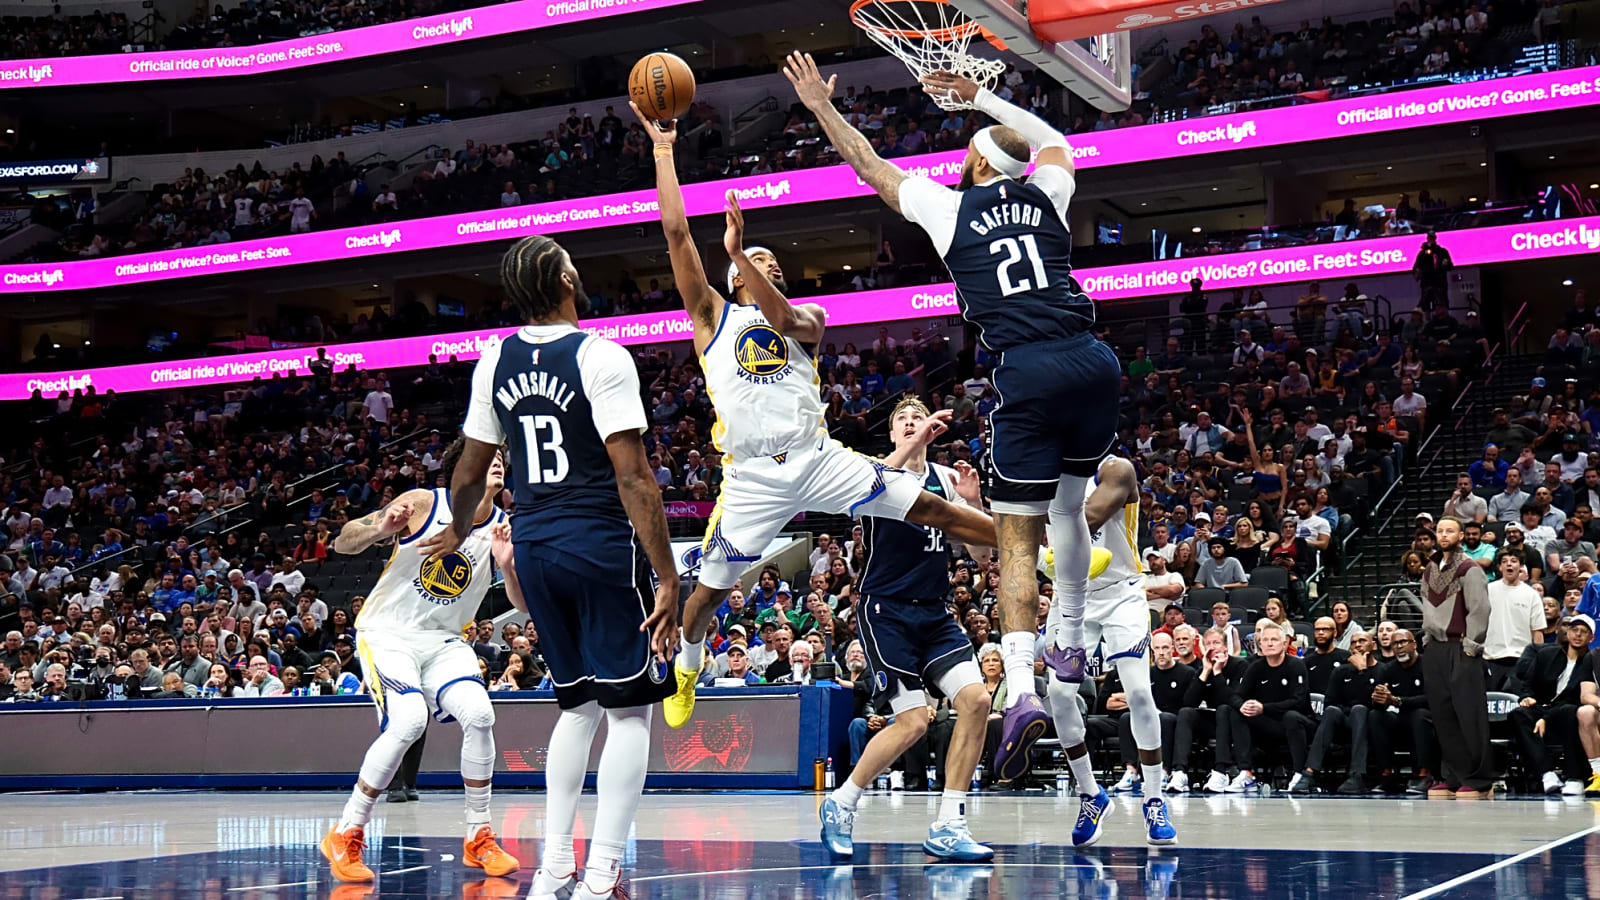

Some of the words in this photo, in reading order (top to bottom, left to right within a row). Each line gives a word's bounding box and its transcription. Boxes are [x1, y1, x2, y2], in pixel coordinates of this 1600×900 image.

[546, 0, 589, 16] Official
[413, 23, 449, 39] Check
[451, 16, 472, 36] lyft
[130, 60, 173, 72] Official
[176, 59, 199, 70] ride
[202, 57, 214, 68] of
[216, 55, 255, 67] Voice?
[257, 52, 287, 64] Gone.
[289, 46, 314, 59] Feet:
[316, 43, 343, 54] Sore.
[29, 65, 52, 82] lyft
[652, 65, 667, 110] Wilson
[1337, 106, 1392, 124] Official
[1395, 103, 1425, 117] ride
[1428, 99, 1444, 113] of
[1446, 92, 1498, 110] Voice?
[1501, 89, 1548, 104] Gone.
[1551, 81, 1592, 97] Feet:
[1178, 127, 1226, 145] Check
[1227, 121, 1256, 142] lyft
[930, 163, 946, 176] of
[766, 180, 790, 200] lyft
[457, 220, 495, 234] Official
[497, 218, 518, 230] ride
[520, 215, 531, 227] of
[532, 211, 568, 225] Voice?
[570, 209, 601, 220] Gone.
[603, 204, 630, 216] Feet:
[632, 202, 659, 213] Sore.
[970, 203, 1042, 236] GAFFORD
[346, 234, 379, 248] Check
[380, 230, 401, 247] lyft
[1512, 229, 1577, 250] Check
[116, 263, 148, 275] Official
[150, 261, 168, 271] ride
[169, 259, 181, 269] of
[180, 255, 211, 268] Voice?
[213, 254, 240, 264] Gone.
[242, 250, 265, 261] Feet:
[267, 248, 291, 258] Sore.
[989, 234, 1049, 296] 21
[1083, 273, 1143, 293] Official
[1146, 270, 1178, 286] ride
[1201, 261, 1257, 280] Voice?
[1259, 257, 1311, 275] Gone.
[1314, 253, 1357, 270] Feet:
[1361, 250, 1406, 265] Sore.
[5, 273, 41, 284] Check
[42, 270, 63, 285] lyft
[622, 323, 647, 337] ride
[650, 321, 664, 334] of
[432, 339, 474, 355] Check
[768, 339, 779, 354] 4
[335, 352, 365, 365] Sore.
[151, 368, 191, 382] Official
[193, 366, 215, 378] ride
[217, 364, 228, 376] of
[228, 360, 266, 374] Voice?
[269, 359, 302, 371] Gone.
[27, 378, 68, 392] Check
[496, 371, 576, 412] MARSHALL
[519, 415, 569, 484] 13
[923, 525, 944, 552] 32
[462, 548, 478, 567] STATE
[451, 564, 467, 580] 15
